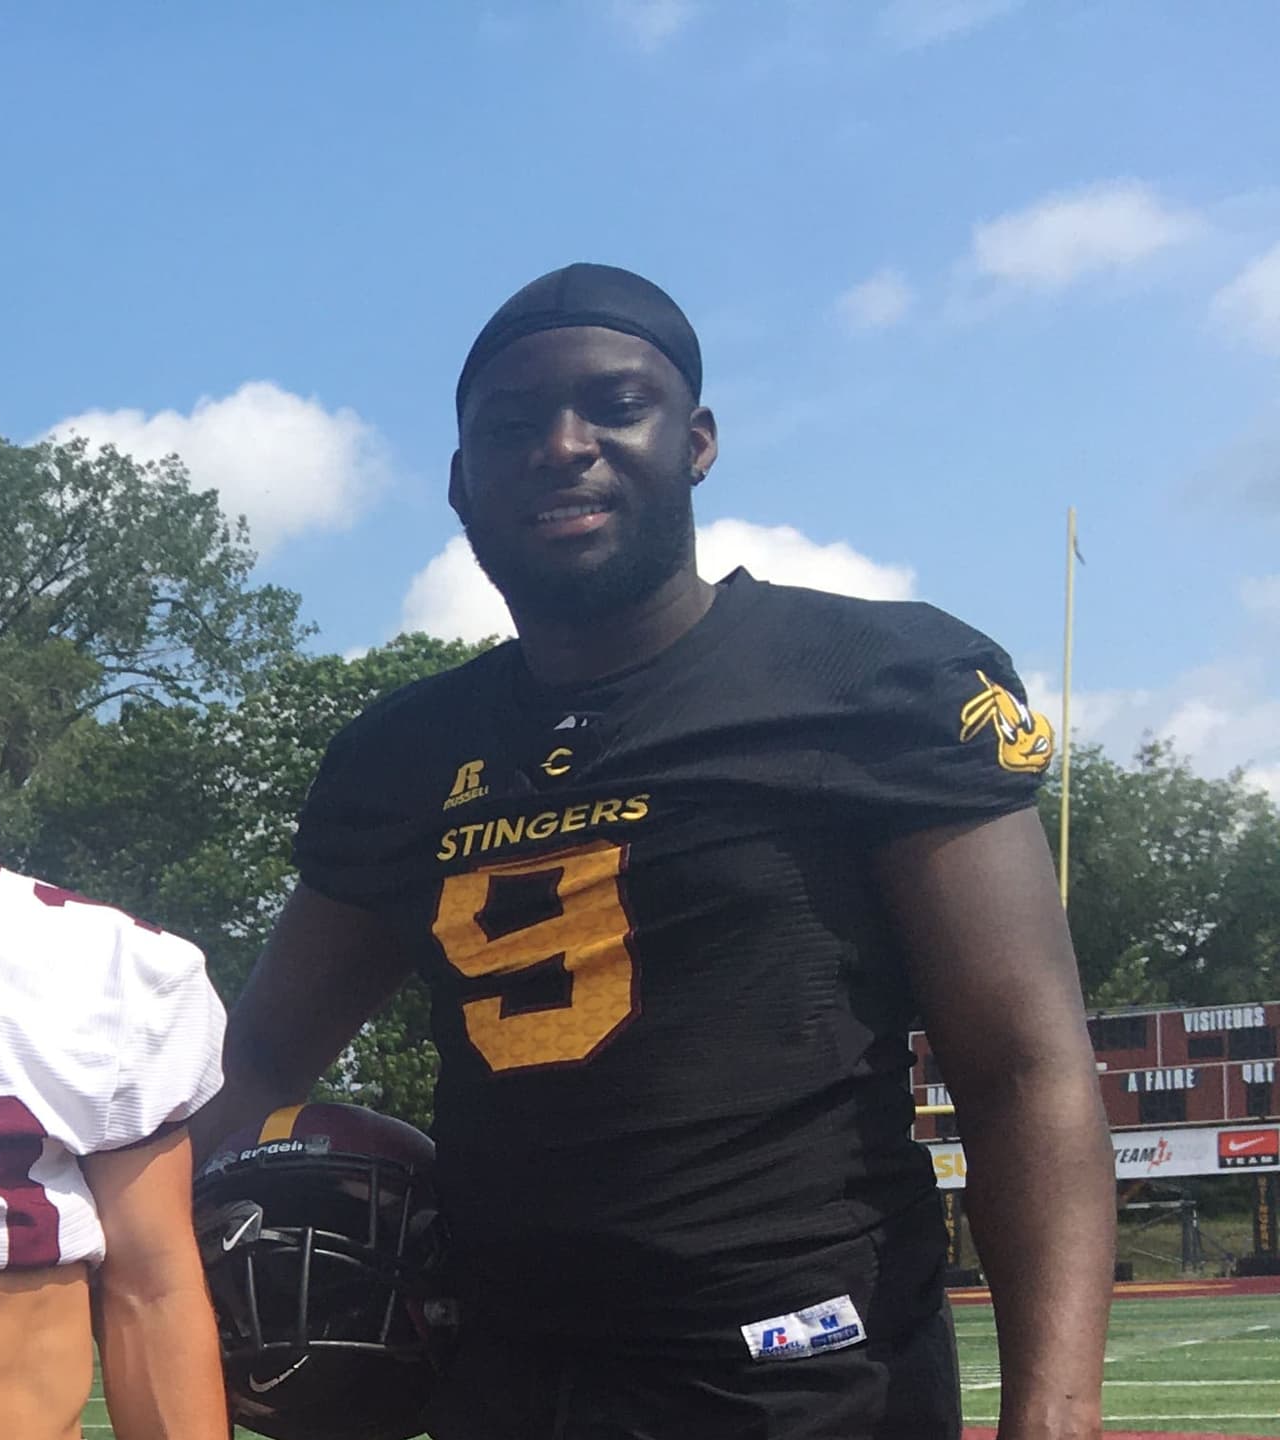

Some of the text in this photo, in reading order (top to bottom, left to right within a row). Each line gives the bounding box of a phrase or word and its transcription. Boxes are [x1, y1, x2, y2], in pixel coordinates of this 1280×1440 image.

[442, 785, 489, 811] RUSSELL
[436, 793, 651, 862] STINGERS
[431, 838, 634, 1073] 9
[1183, 1005, 1266, 1033] VISITEURS
[1144, 1067, 1197, 1092] FAIRE
[240, 1140, 304, 1161] Ridell
[1224, 1155, 1274, 1168] TEAM
